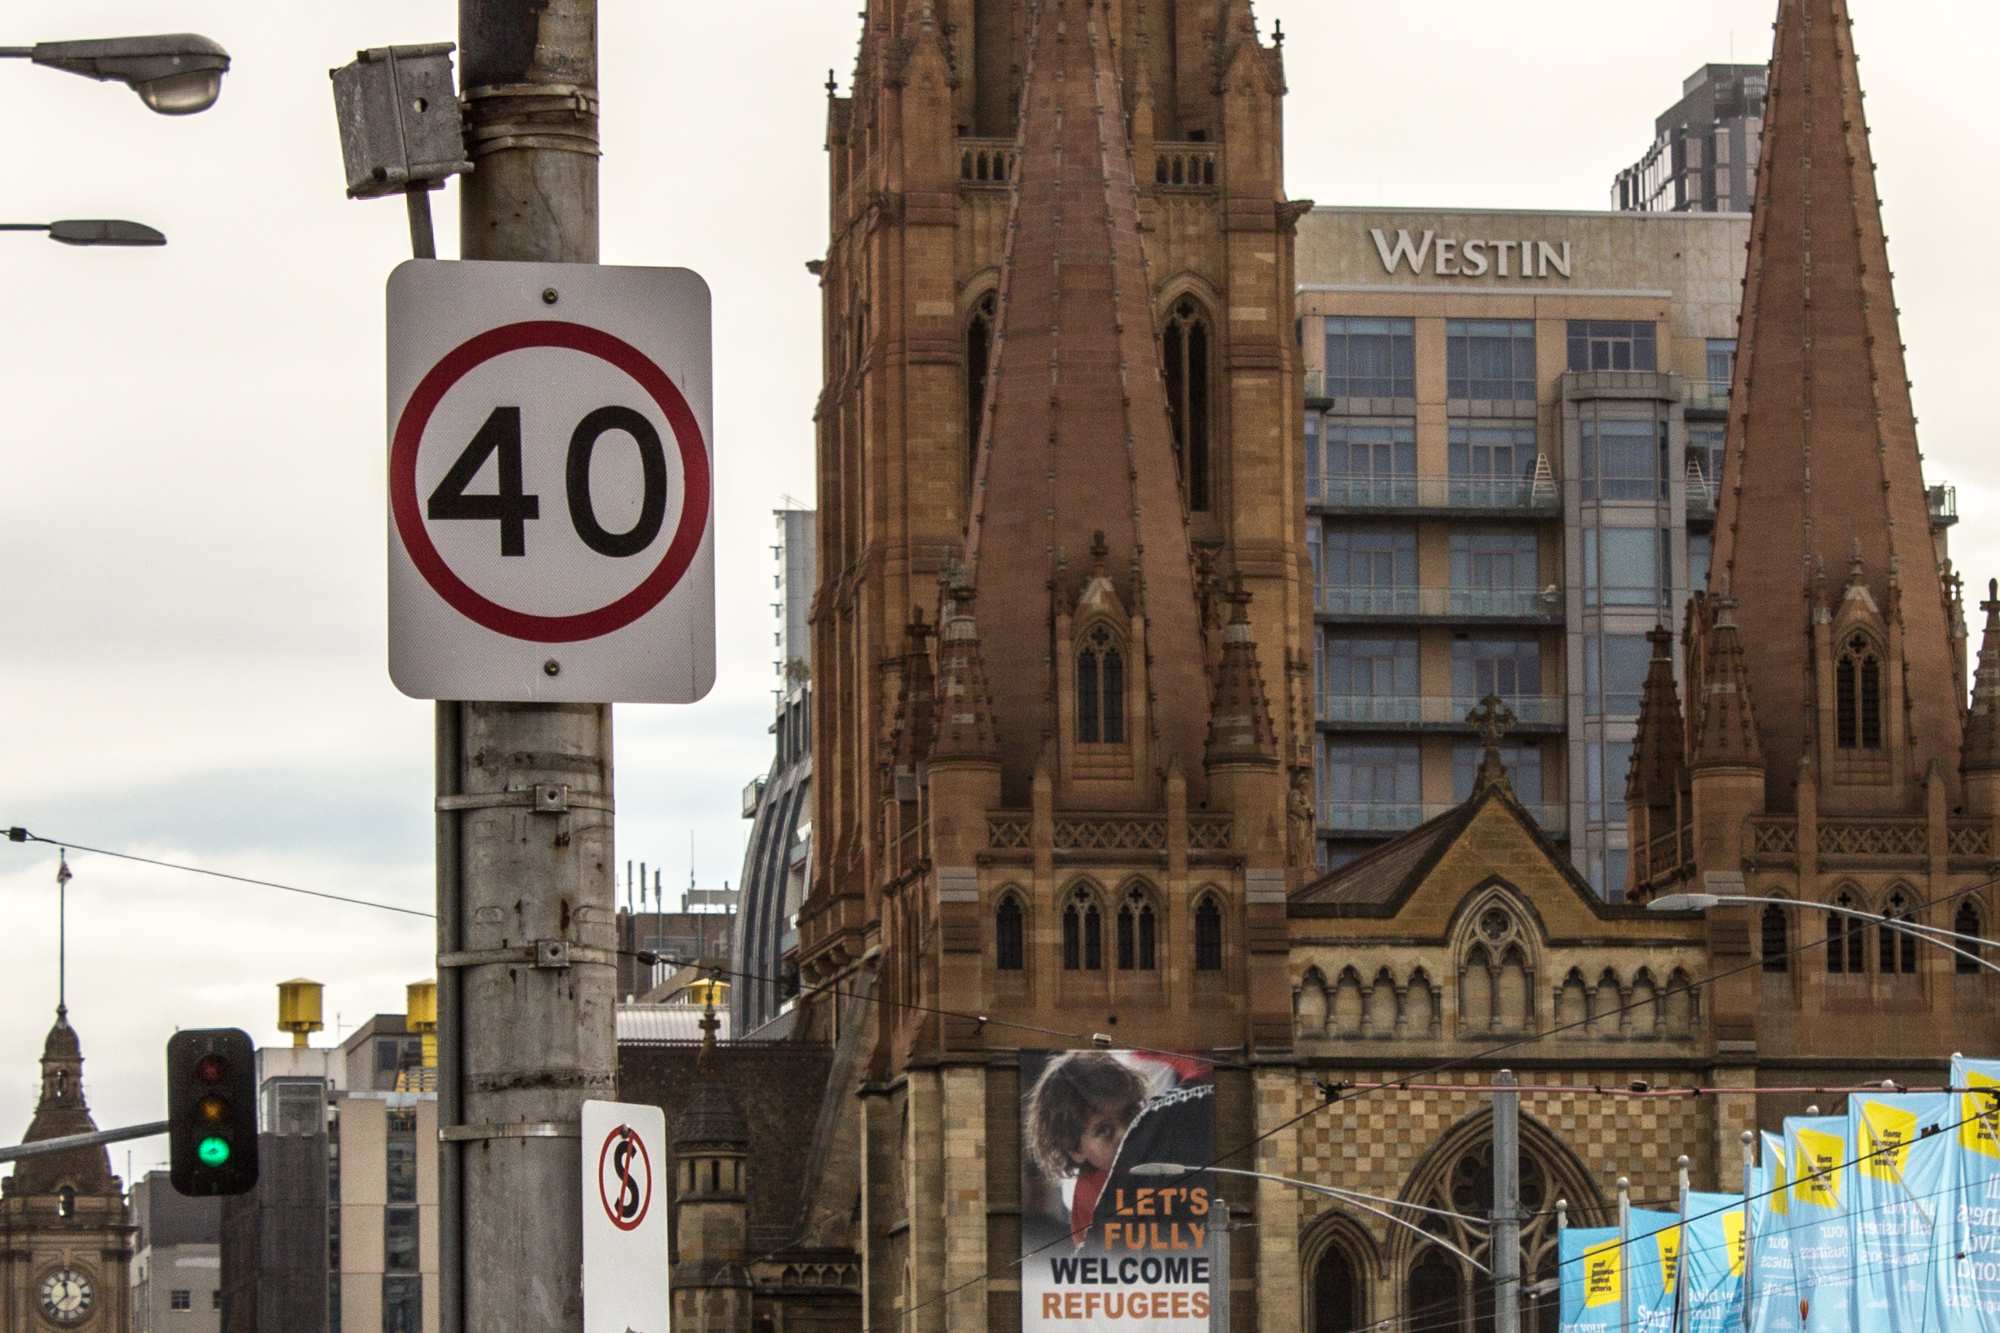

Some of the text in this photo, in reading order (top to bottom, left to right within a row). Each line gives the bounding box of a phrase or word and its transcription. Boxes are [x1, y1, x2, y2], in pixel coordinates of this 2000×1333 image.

[1370, 228, 1571, 278] WESTIN
[427, 405, 667, 558] 40
[1115, 1187, 1210, 1216] LET'S
[1104, 1222, 1206, 1249] FULLY
[1050, 1257, 1210, 1285] WELCOME
[1042, 1291, 1211, 1320] REFUGEES
